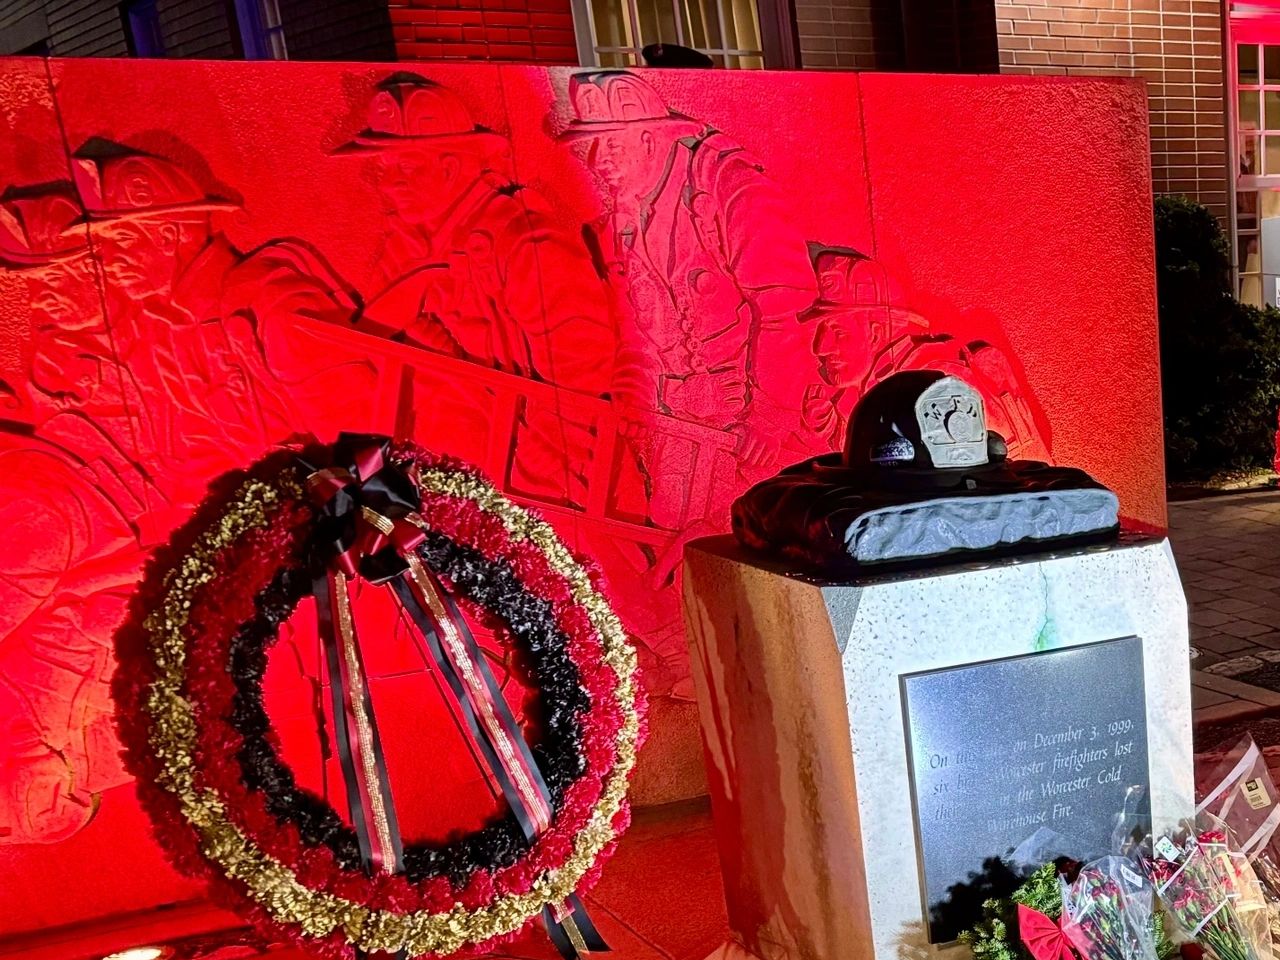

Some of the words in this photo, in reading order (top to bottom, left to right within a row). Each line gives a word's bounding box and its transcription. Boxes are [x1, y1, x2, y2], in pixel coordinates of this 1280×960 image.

[929, 752, 948, 769] On
[1013, 740, 1027, 754] on
[1034, 725, 1084, 749] December
[933, 778, 950, 796] six
[1052, 745, 1108, 774] firefighters
[1114, 740, 1134, 757] lost
[1017, 784, 1035, 803] the
[1040, 776, 1092, 797] Worcester
[1097, 764, 1122, 784] Cold
